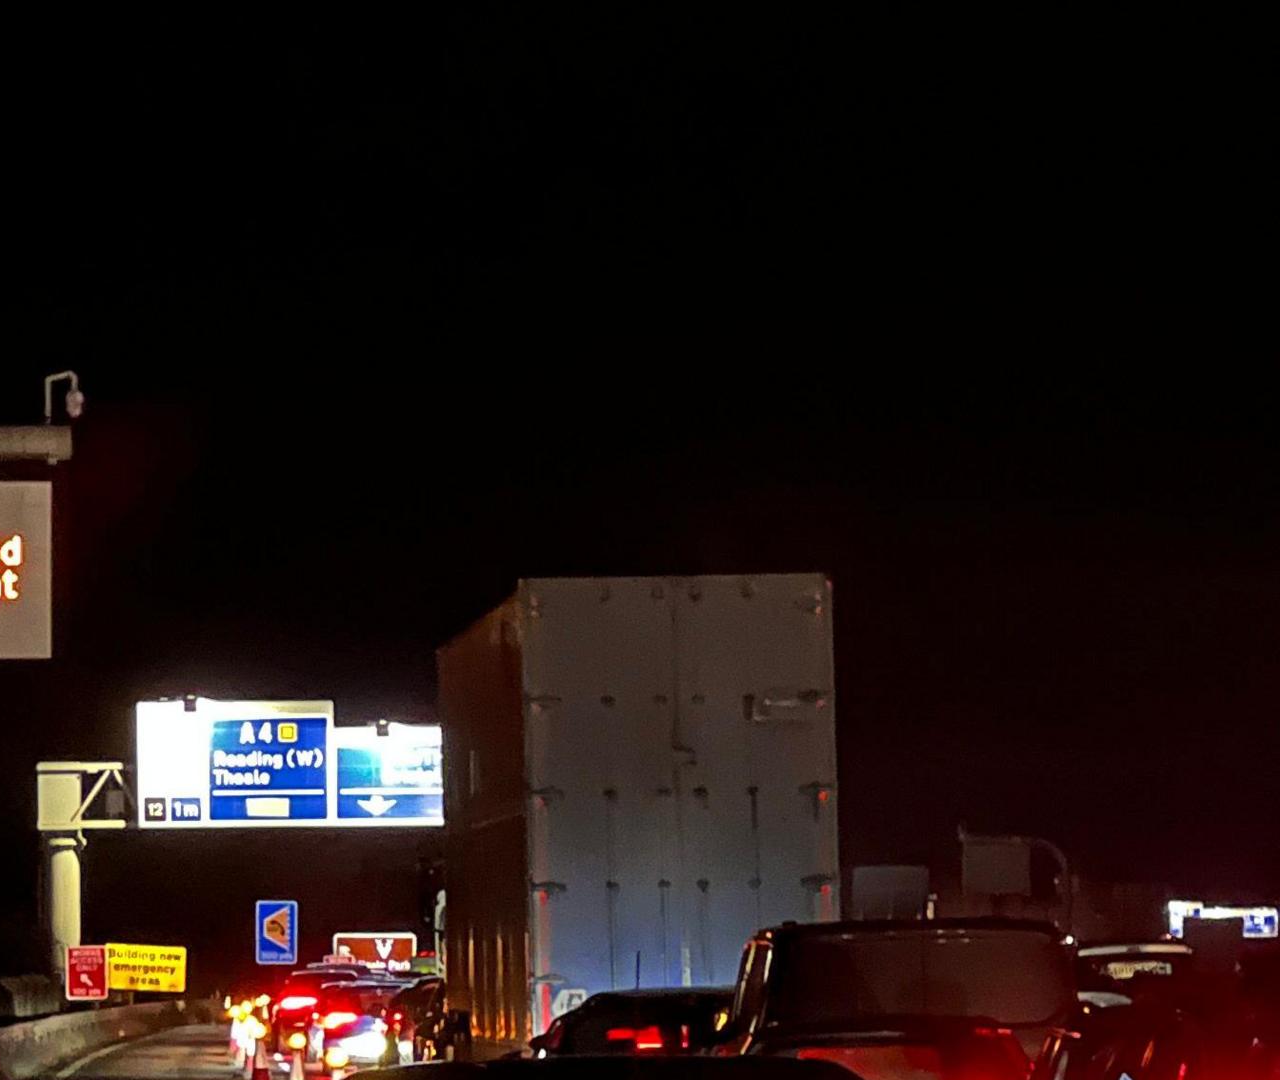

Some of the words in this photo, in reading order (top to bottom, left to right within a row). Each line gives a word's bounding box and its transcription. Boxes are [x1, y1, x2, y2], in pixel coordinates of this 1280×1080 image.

[286, 748, 323, 768] (W)
[109, 949, 156, 961] Building
[114, 964, 175, 975] emergency
